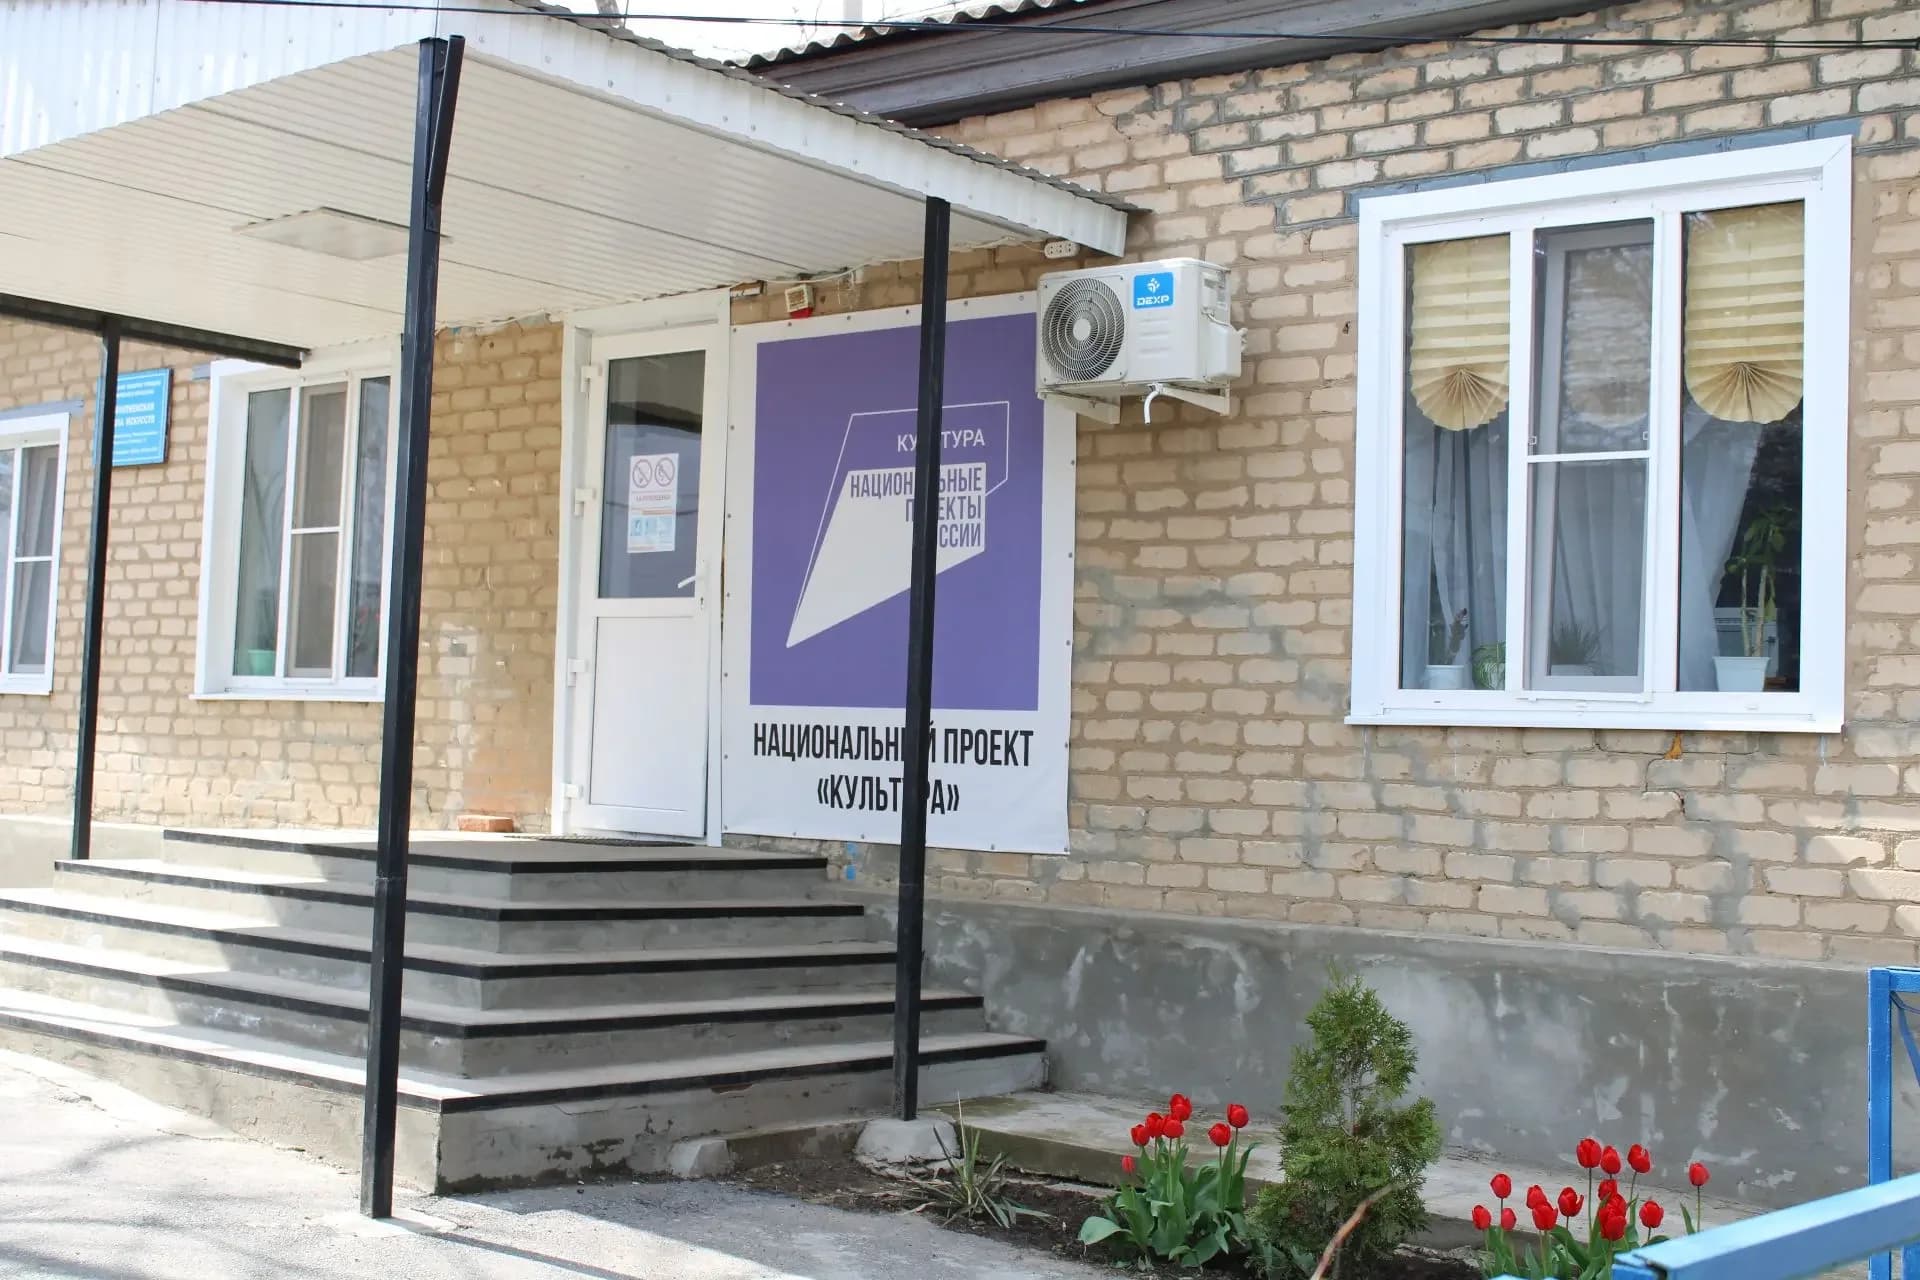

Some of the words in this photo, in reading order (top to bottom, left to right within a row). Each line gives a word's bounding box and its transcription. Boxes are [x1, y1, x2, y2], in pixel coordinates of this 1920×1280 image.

[1136, 295, 1170, 306] DEXP
[897, 428, 985, 452] КУТУРА
[850, 467, 983, 499] НАЦИОНЬНЫЕ
[905, 495, 982, 522] ПЕКТЫ
[938, 522, 981, 548] ССИИ
[753, 720, 936, 762] НАЦИОНАЛЬНЙ
[944, 728, 1035, 767] ПРОЕКТ
[817, 774, 960, 815] «КУЛЬТА»
